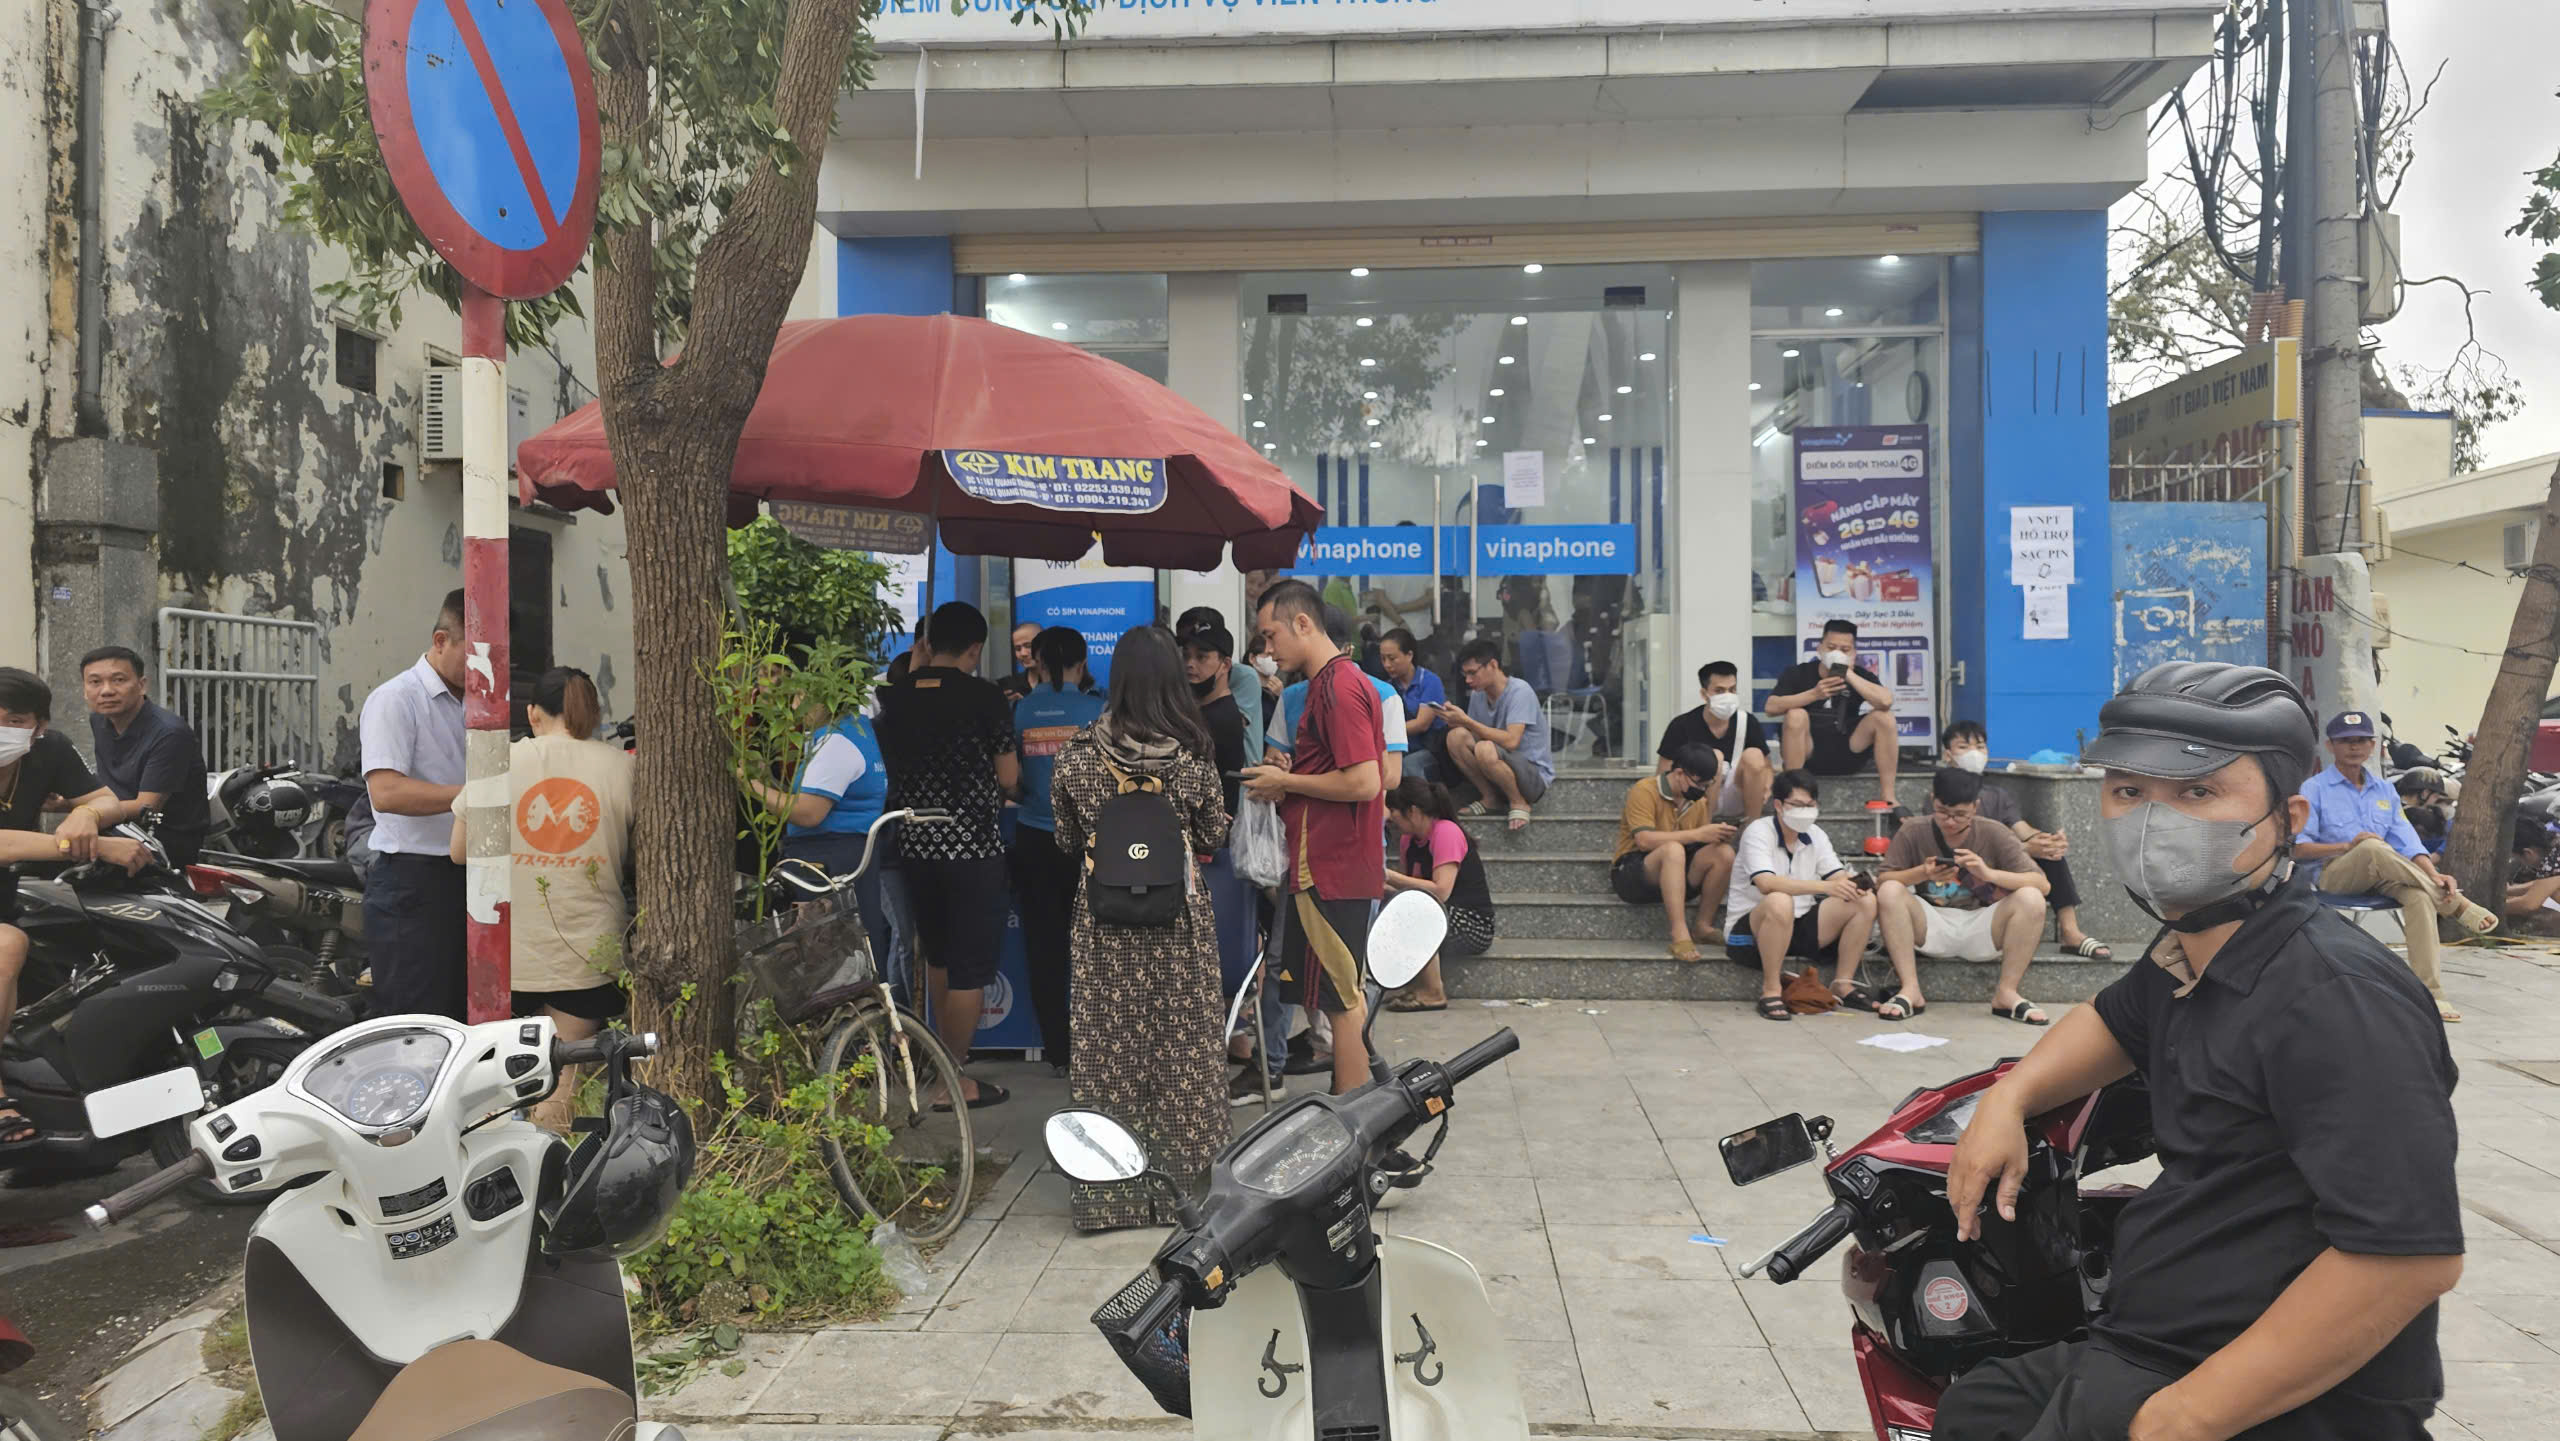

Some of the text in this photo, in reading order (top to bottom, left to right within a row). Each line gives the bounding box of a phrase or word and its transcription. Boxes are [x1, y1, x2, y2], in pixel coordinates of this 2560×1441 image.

[2212, 371, 2237, 406] VIỆT
[2239, 363, 2268, 396] NAM
[1004, 455, 1154, 483] KIM TRANG
[1838, 519, 1865, 539] 2G
[1888, 510, 1920, 529] 4G
[2027, 515, 2060, 525] VNPT
[1485, 536, 1616, 562] vinaphone
[2048, 549, 2070, 559] PIN
[1062, 607, 1077, 616] SIM
[1078, 607, 1126, 616] VINAPHONE
[1082, 632, 1118, 642] THANH
[2291, 614, 2324, 658] MÔ
[2302, 666, 2316, 701] A
[136, 984, 188, 992] HONDA
